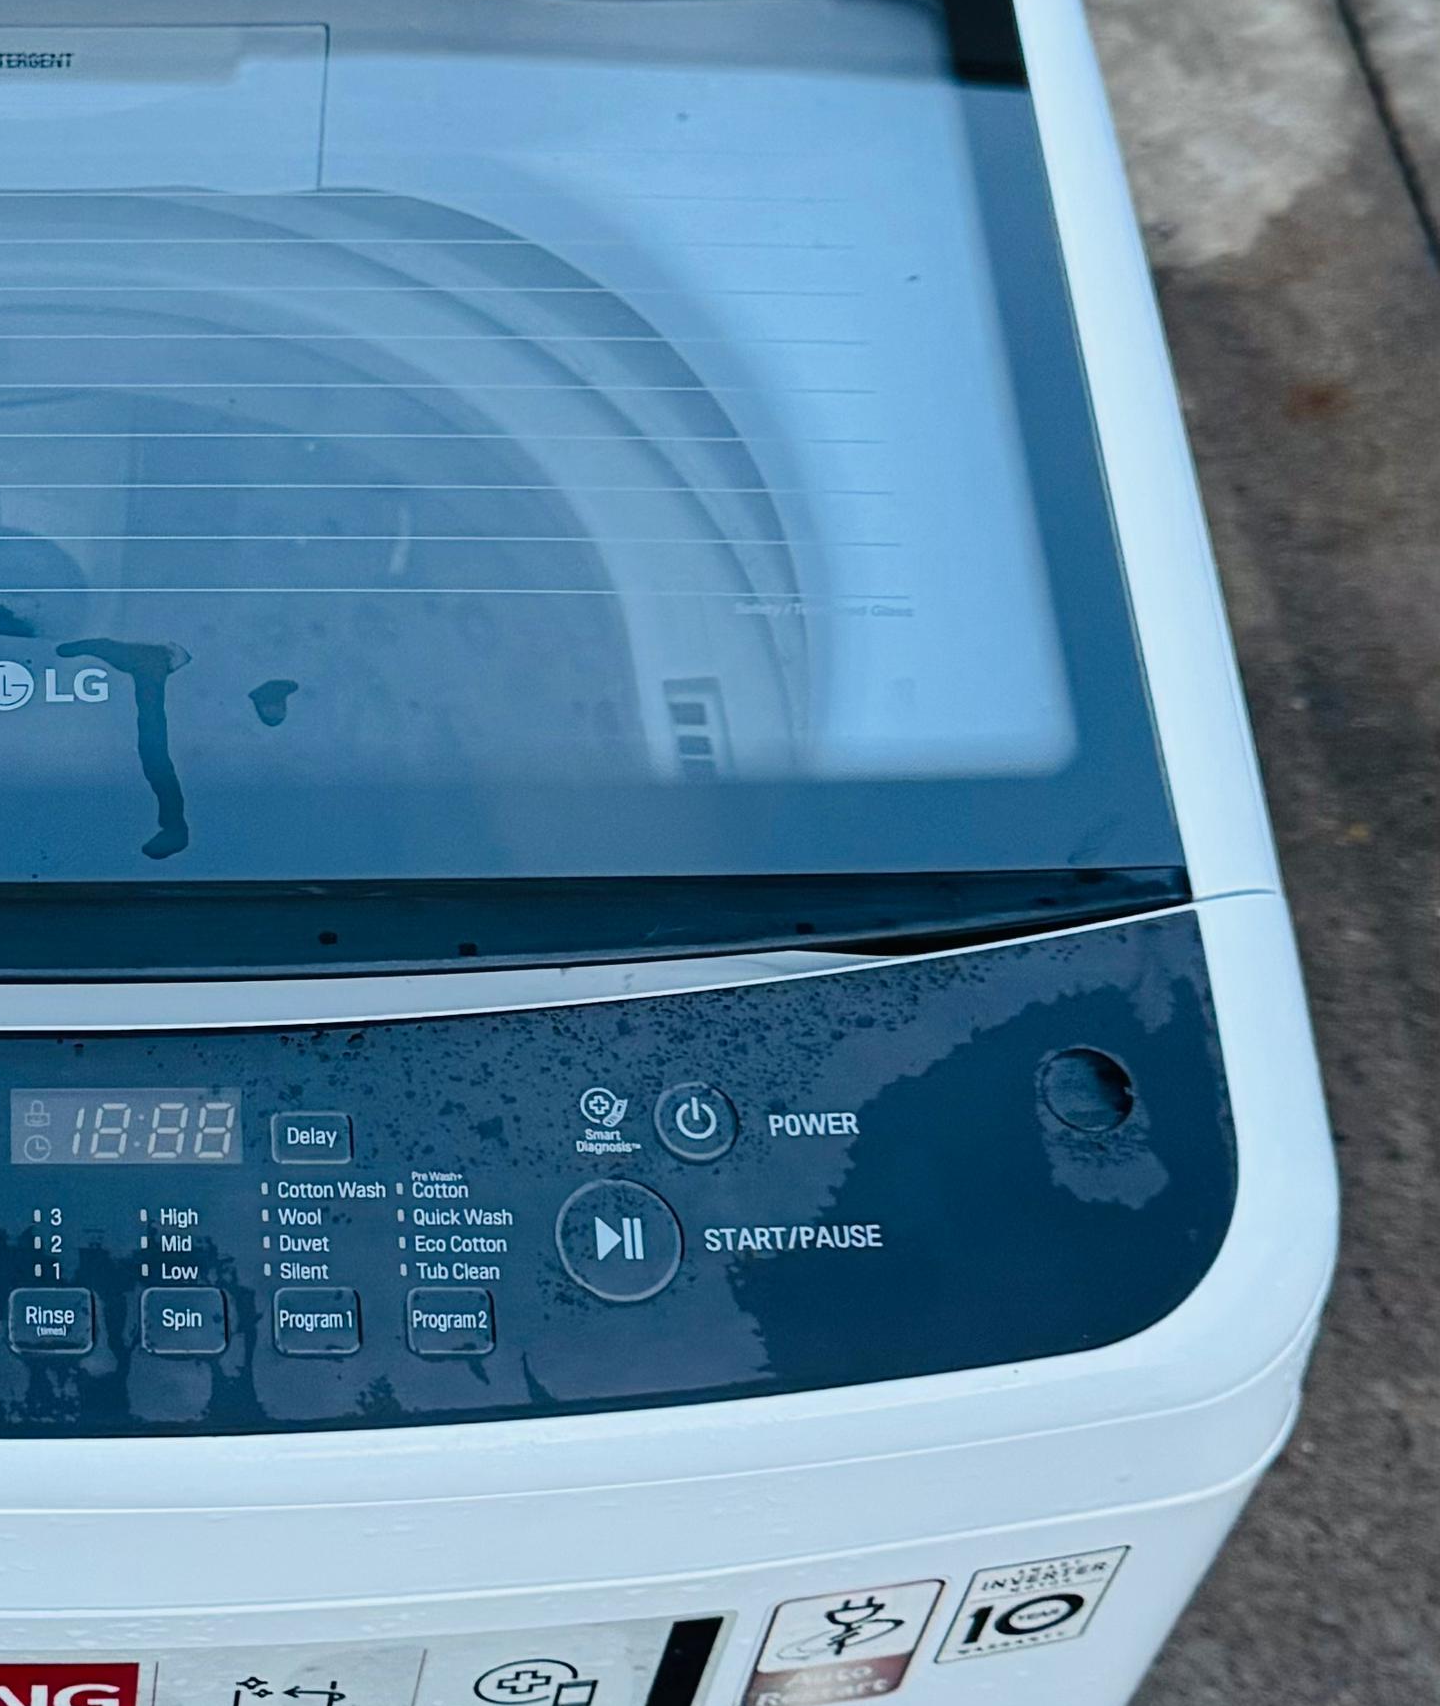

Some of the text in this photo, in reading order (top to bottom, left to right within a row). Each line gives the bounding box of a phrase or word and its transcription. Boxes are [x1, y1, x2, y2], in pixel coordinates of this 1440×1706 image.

[45, 668, 109, 703] LG
[769, 1112, 859, 1137] POWER
[287, 1127, 337, 1148] Delay
[585, 1128, 621, 1141] Smart
[411, 1171, 428, 1182] Pre
[278, 1182, 386, 1198] Cotton Wash
[412, 1181, 469, 1199] Cotton
[50, 1208, 62, 1225] 3
[161, 1208, 198, 1228] High
[278, 1208, 322, 1225] Wool
[413, 1209, 513, 1226] Quick Wash
[50, 1236, 62, 1252] 2
[162, 1236, 192, 1252] Mid
[279, 1236, 330, 1252] Duvet
[415, 1236, 507, 1252] Eco Cotton
[704, 1225, 883, 1251] START/PAUSE
[53, 1263, 61, 1279] 1
[162, 1263, 198, 1280] Low
[280, 1263, 329, 1280] Silent
[416, 1263, 500, 1280] Tub Clean
[26, 1306, 75, 1326] Rinse
[162, 1308, 202, 1331] Spin
[280, 1310, 353, 1331] Program 1
[412, 1310, 487, 1331] Program 2
[981, 1561, 1107, 1591] INVERTER
[961, 1594, 1084, 1644] 10
